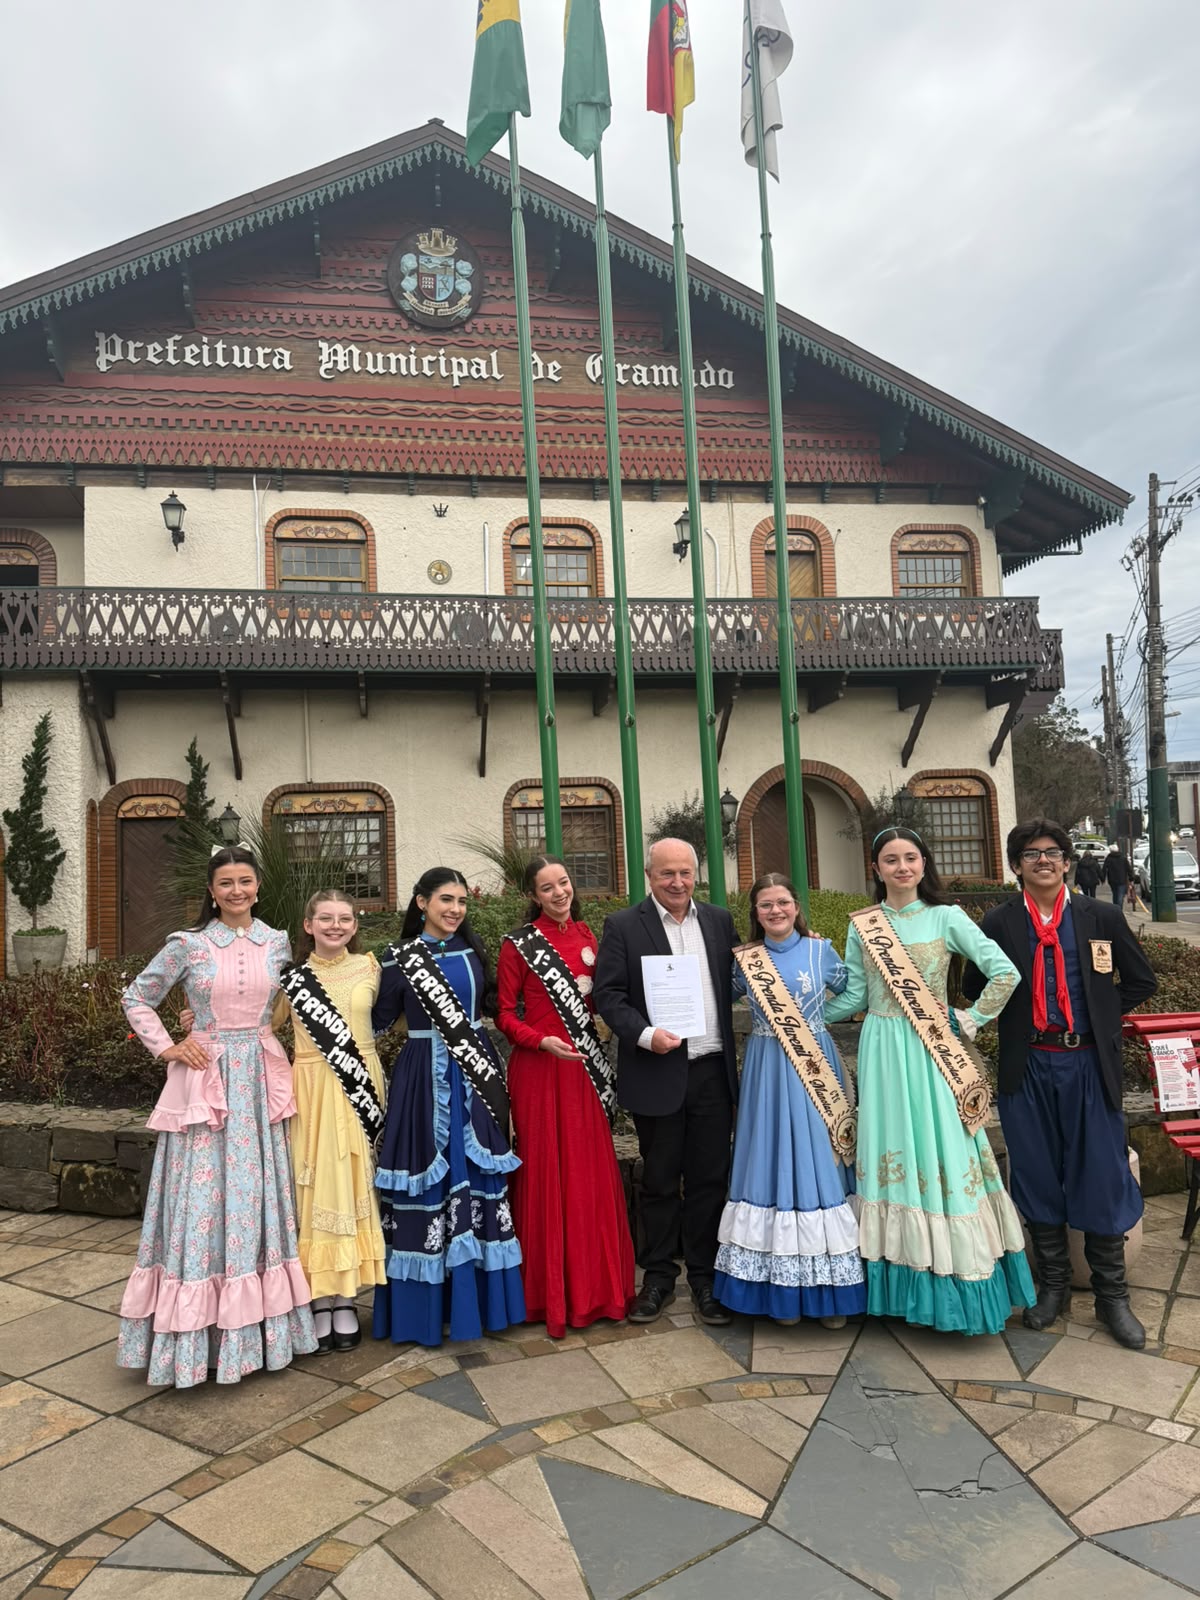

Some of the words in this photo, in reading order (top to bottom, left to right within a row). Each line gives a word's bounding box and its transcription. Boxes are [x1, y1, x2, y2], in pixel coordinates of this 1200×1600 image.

[95, 330, 294, 372] Prefeitura
[318, 339, 504, 387] Municipal
[531, 351, 562, 383] de
[410, 968, 464, 1029] PRENDA
[543, 967, 590, 1029] PRENDA
[868, 936, 904, 976] Prenda
[892, 979, 935, 1020] Juvenil
[292, 988, 352, 1046] PRENDA
[327, 1046, 369, 1085] MIRIM
[752, 971, 787, 1014] Prenda
[774, 1015, 813, 1057] Juvenil
[954, 1054, 968, 1069] CTG
